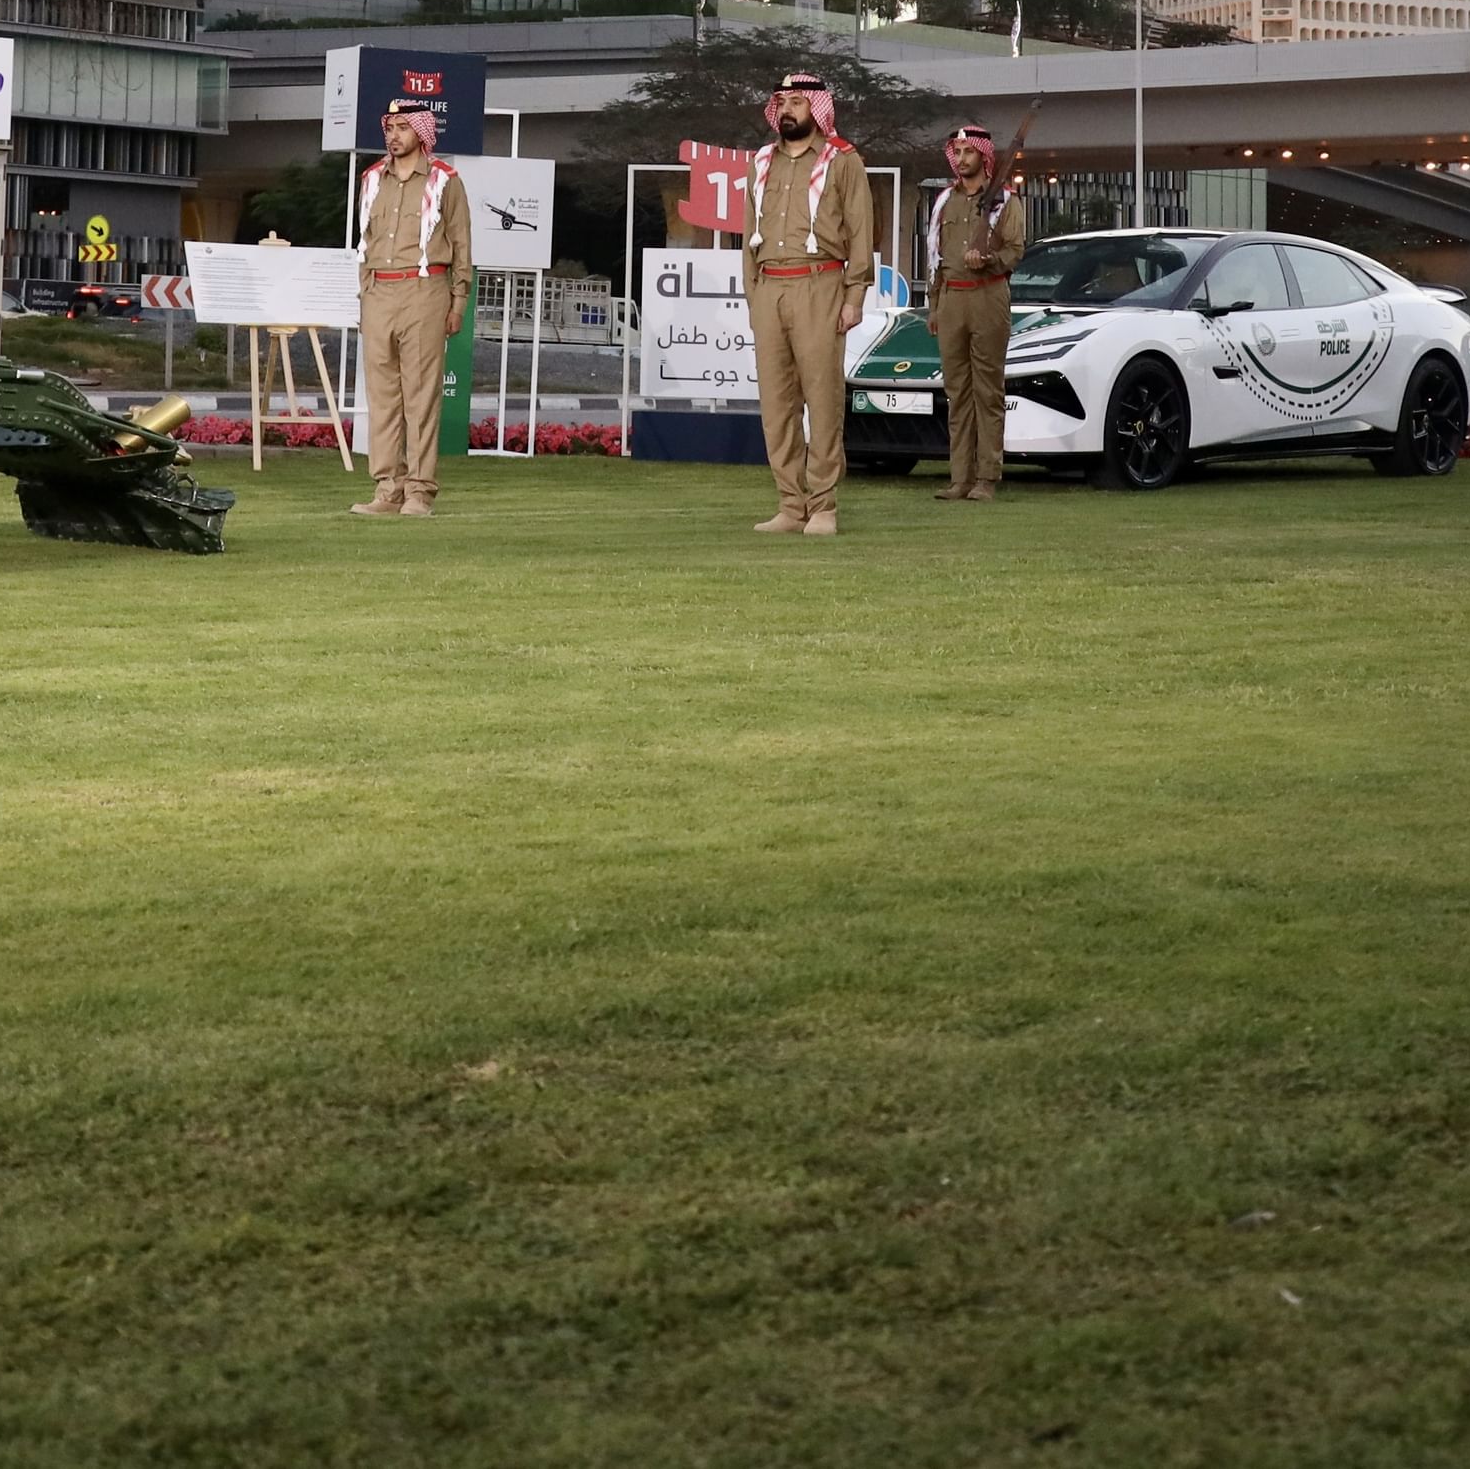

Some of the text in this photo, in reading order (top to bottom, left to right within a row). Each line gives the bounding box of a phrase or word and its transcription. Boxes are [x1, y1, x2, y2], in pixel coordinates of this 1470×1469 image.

[409, 77, 435, 93] 11.5
[430, 100, 448, 113] LIFE
[657, 325, 708, 349] طفل
[1319, 339, 1351, 357] POLICE
[885, 393, 897, 407] 75
